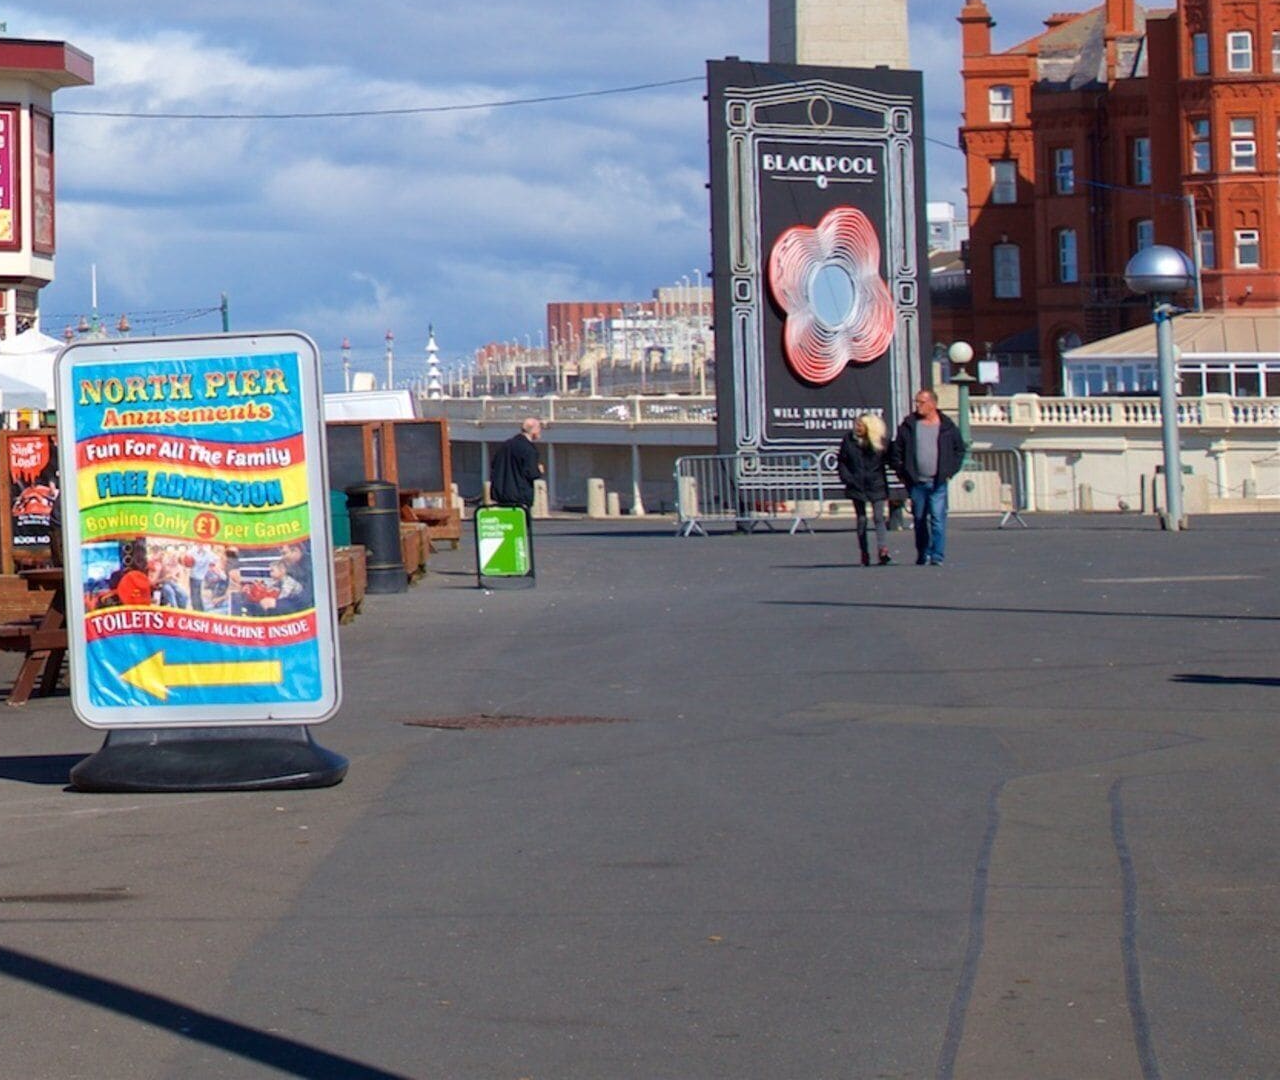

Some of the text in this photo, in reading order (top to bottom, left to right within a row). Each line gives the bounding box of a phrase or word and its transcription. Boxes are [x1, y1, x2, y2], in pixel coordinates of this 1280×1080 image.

[762, 154, 878, 174] BLACKPOOL
[78, 369, 289, 405] NORTH PIER
[102, 401, 273, 430] Amusements
[773, 408, 801, 418] WILL
[804, 408, 838, 418] NEVER
[804, 420, 854, 430] 1914-1918
[86, 438, 291, 468] Fun For All The Family
[95, 470, 285, 507] FREE ADMISSION
[14, 535, 37, 545] BOOK
[86, 512, 301, 541] Bowling Only £1 per Game
[91, 611, 309, 639] TOILETS & CASH MACHINE INSIDE
